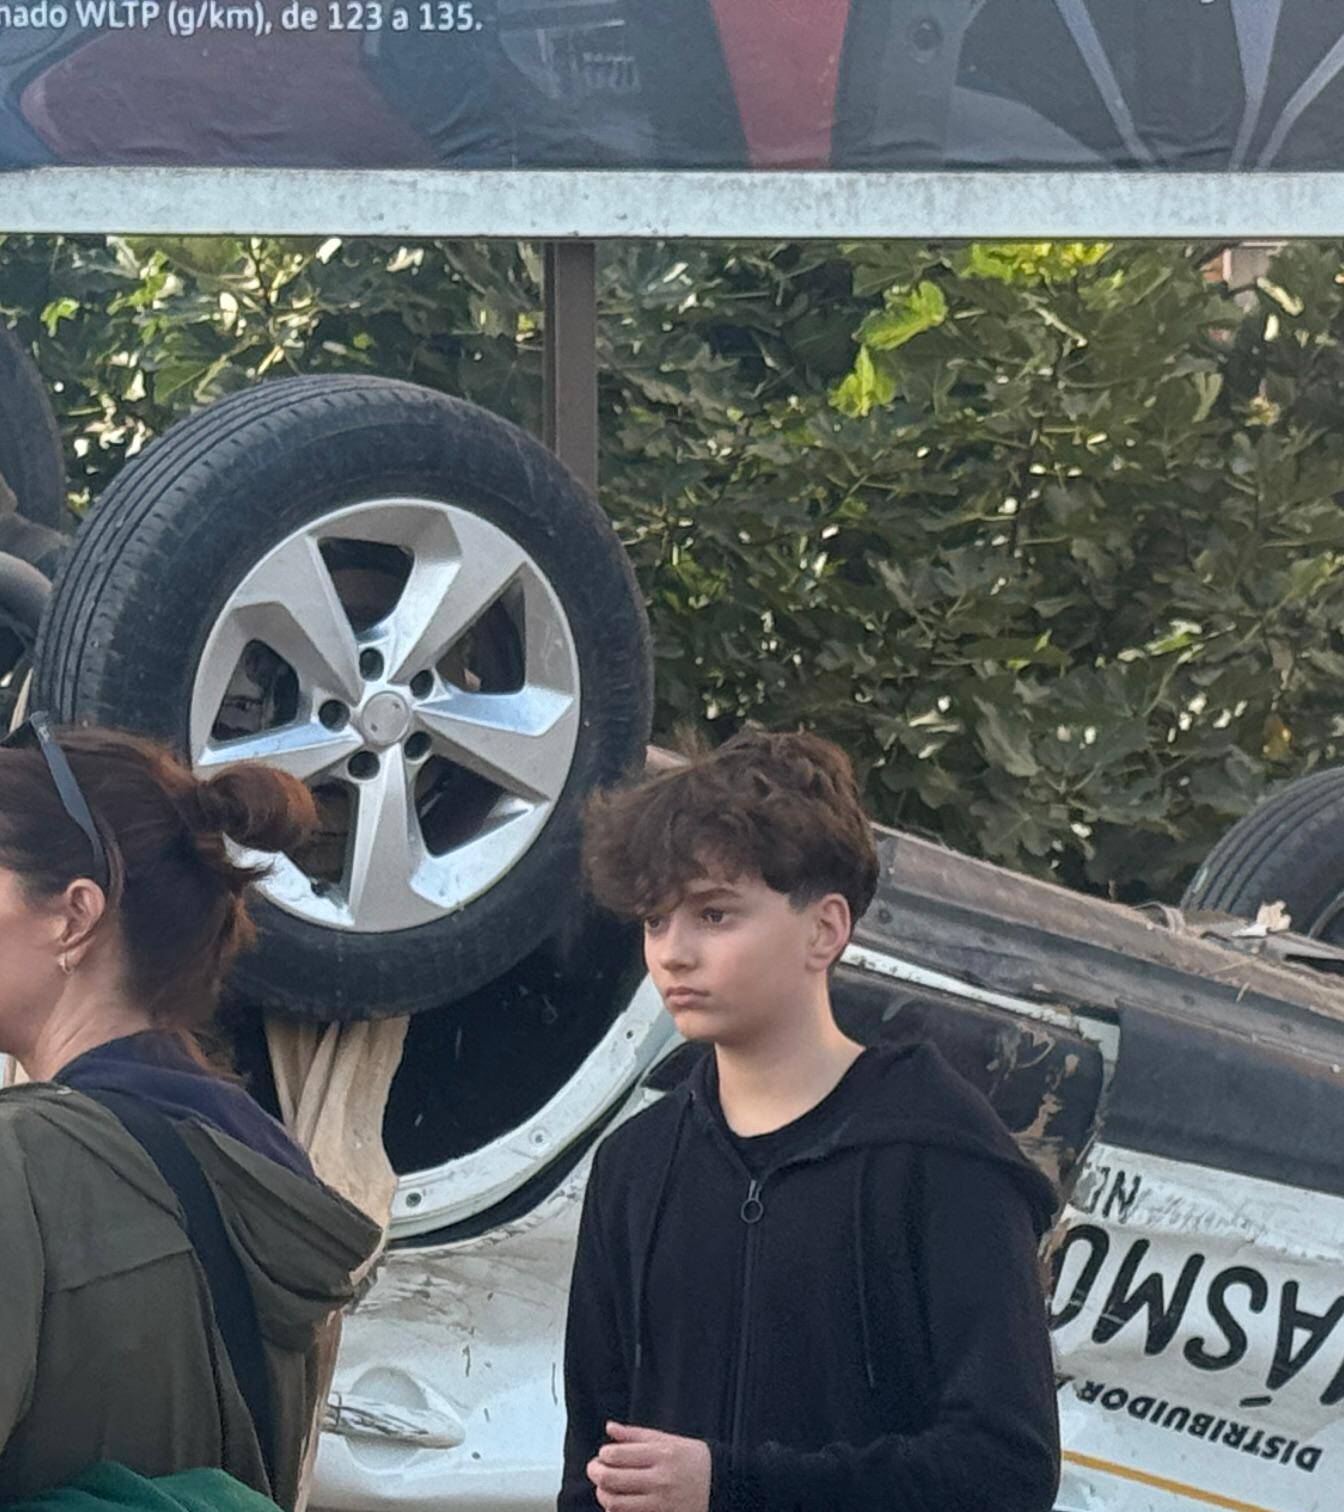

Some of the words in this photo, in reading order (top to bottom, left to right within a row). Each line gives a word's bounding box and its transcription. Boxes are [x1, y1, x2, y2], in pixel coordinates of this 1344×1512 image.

[76, 0, 159, 29] WLTP
[167, 0, 272, 36] (g/km),
[281, 1, 318, 31] de
[328, 2, 383, 31] 123
[391, 8, 408, 31] a
[419, 2, 483, 31] 135.
[1074, 1379, 1323, 1473] DISTRIBUIDOR
